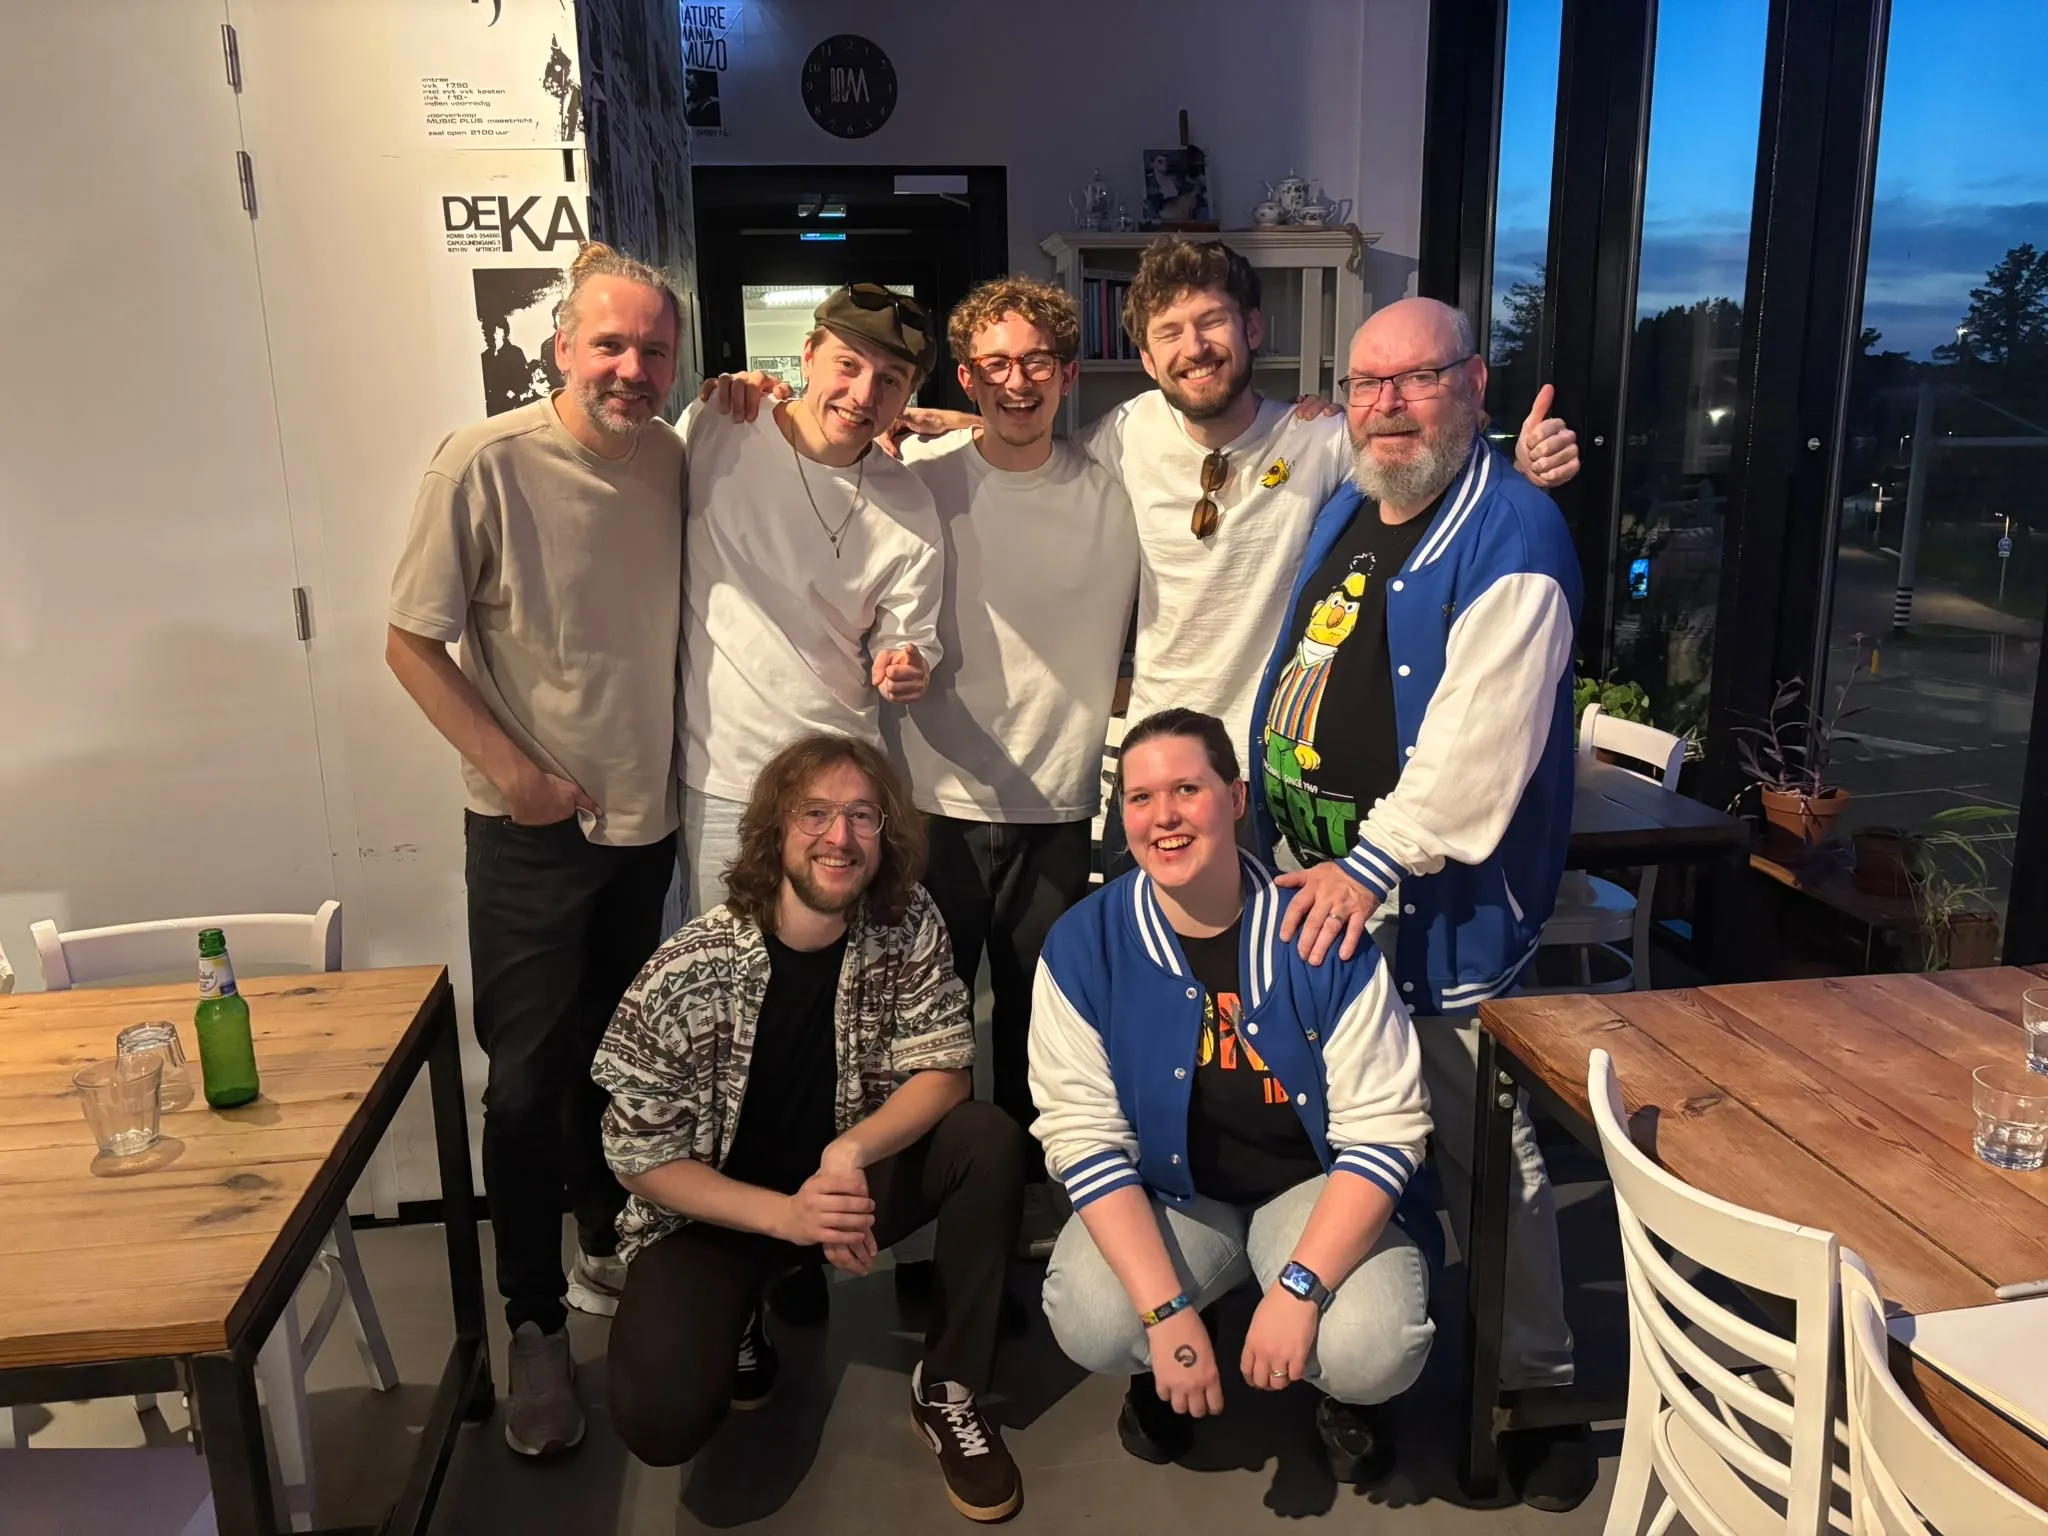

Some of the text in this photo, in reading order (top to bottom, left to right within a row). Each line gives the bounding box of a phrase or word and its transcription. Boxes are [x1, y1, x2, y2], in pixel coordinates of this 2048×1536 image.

[681, 5, 726, 29] ATURE
[442, 196, 592, 252] DEKA
[1264, 769, 1357, 858] ERT
